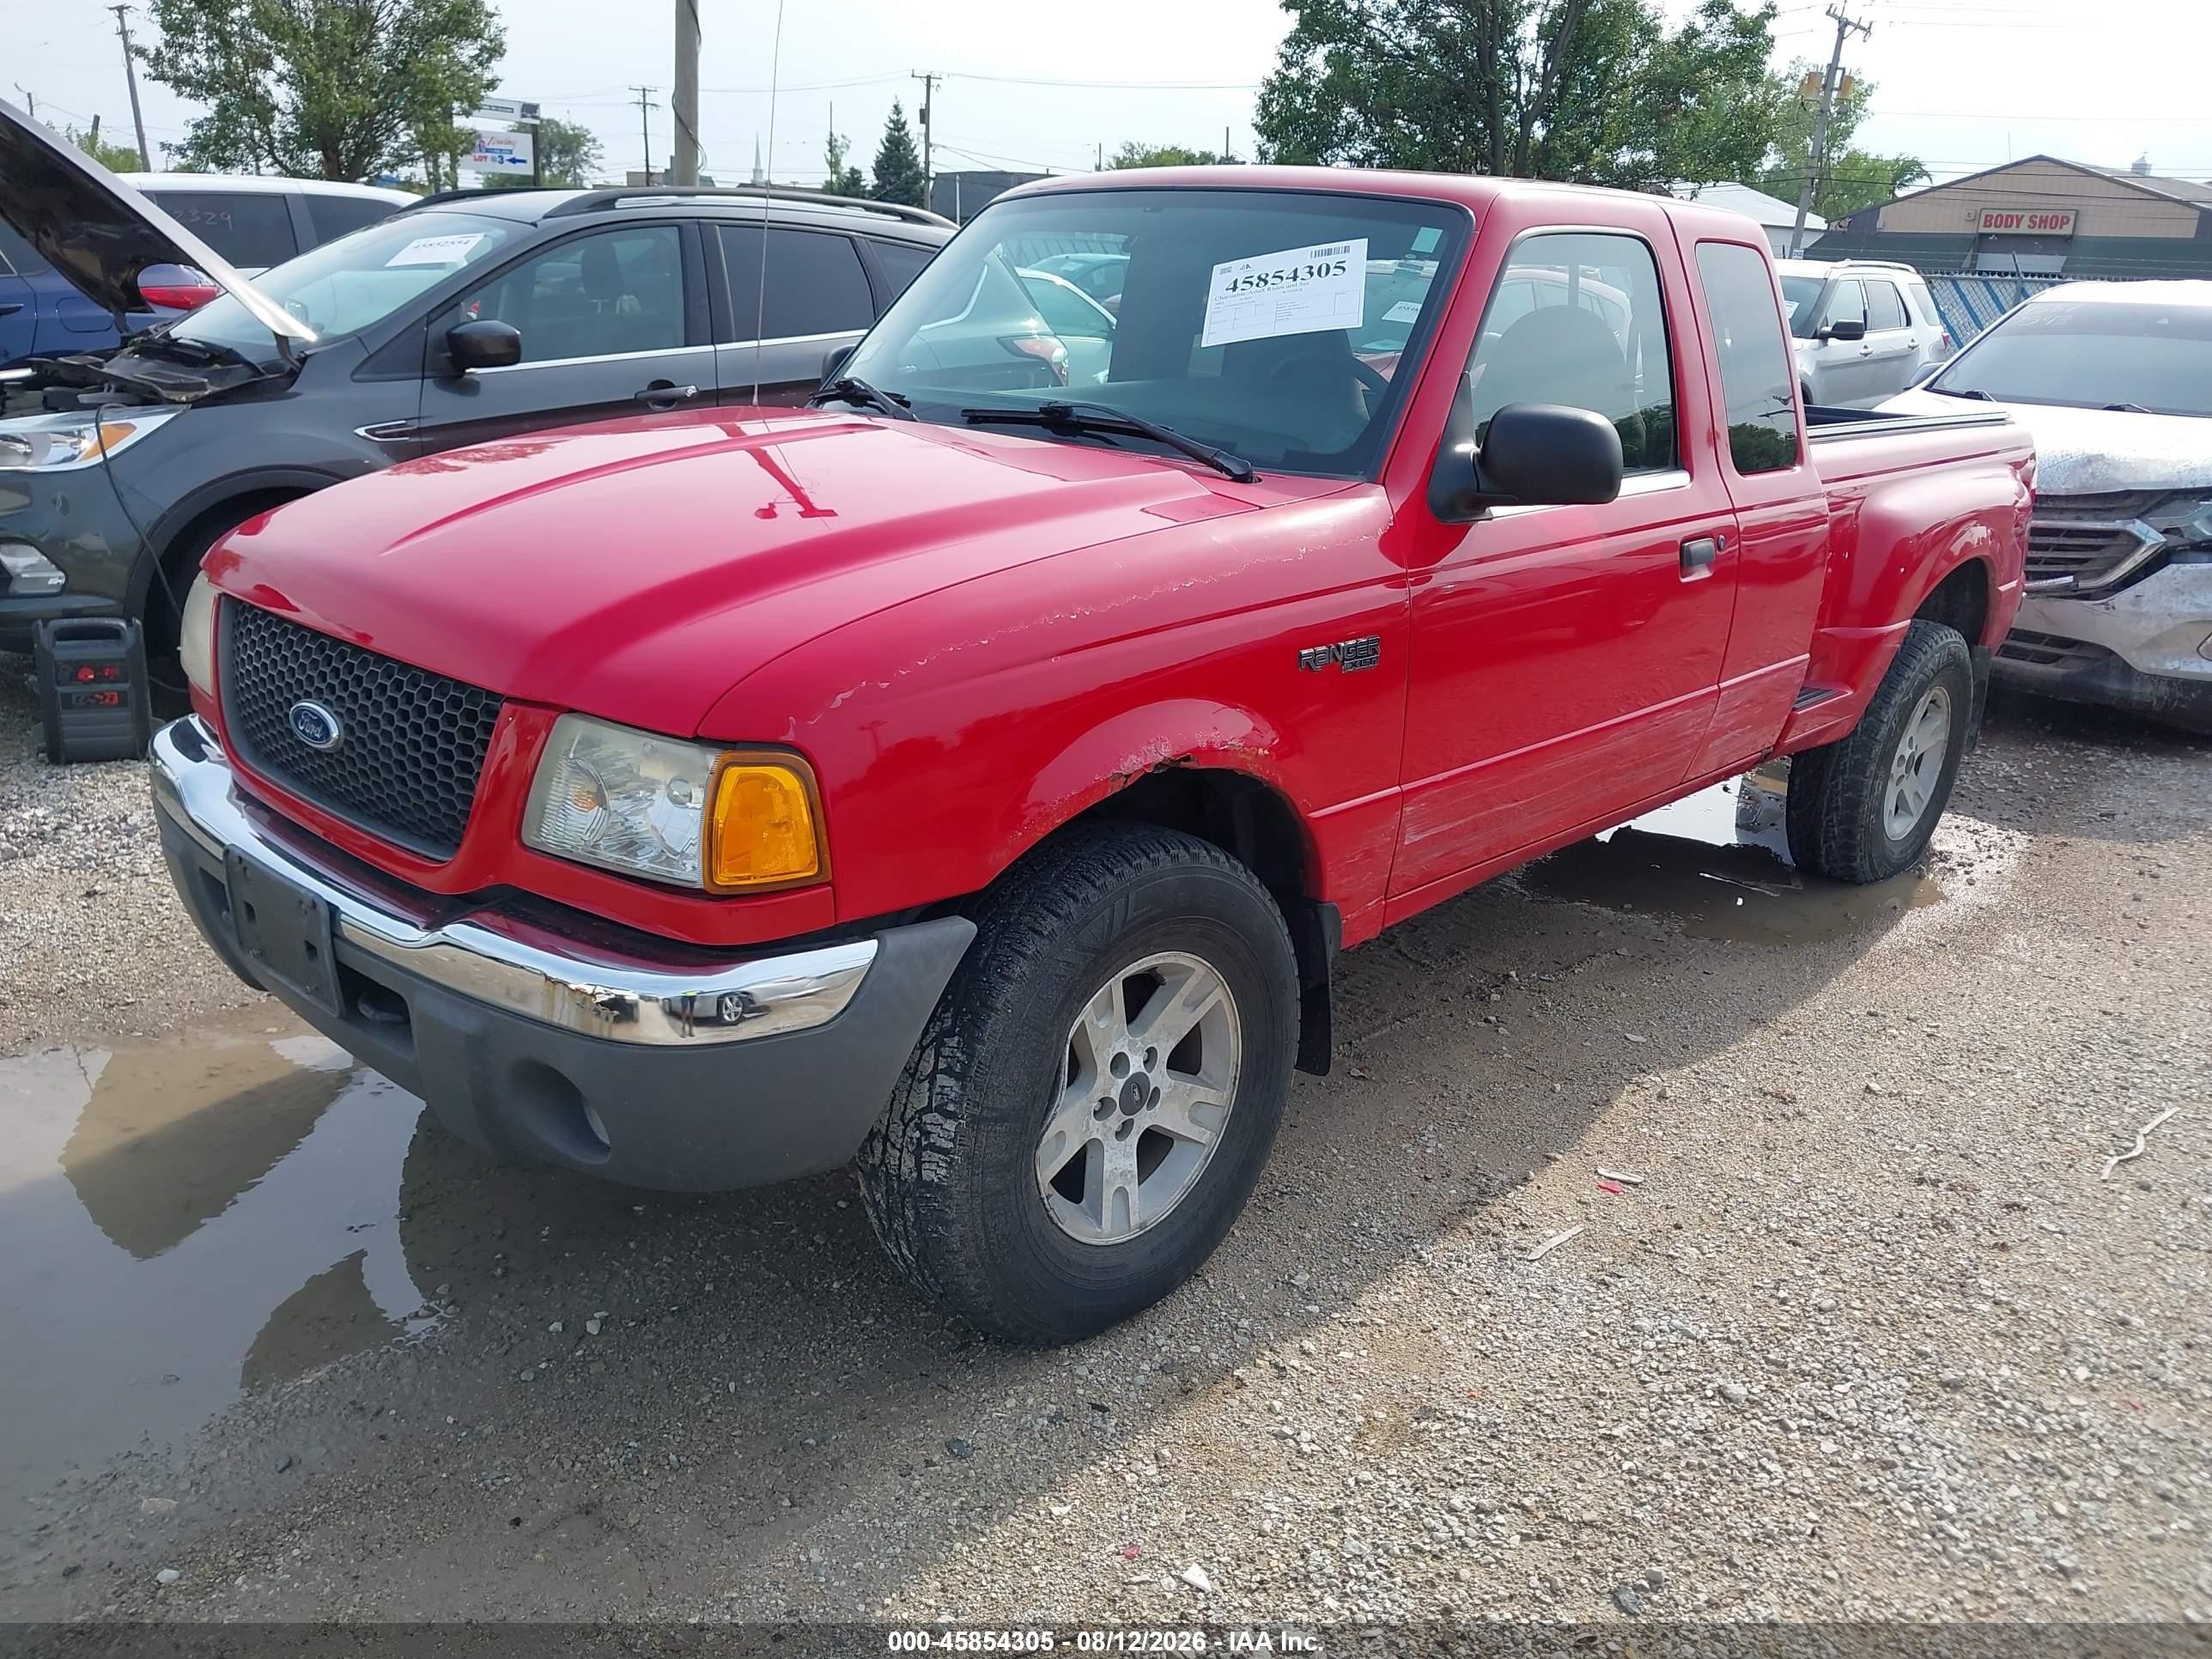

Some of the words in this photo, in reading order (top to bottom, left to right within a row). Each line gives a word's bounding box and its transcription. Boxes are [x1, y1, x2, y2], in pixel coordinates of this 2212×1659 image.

[1982, 213, 2026, 229] BODY
[2027, 214, 2071, 230] SHOP
[1224, 259, 1347, 293] 45854305
[1298, 635, 1382, 673] RANGER
[298, 710, 324, 738] Ford
